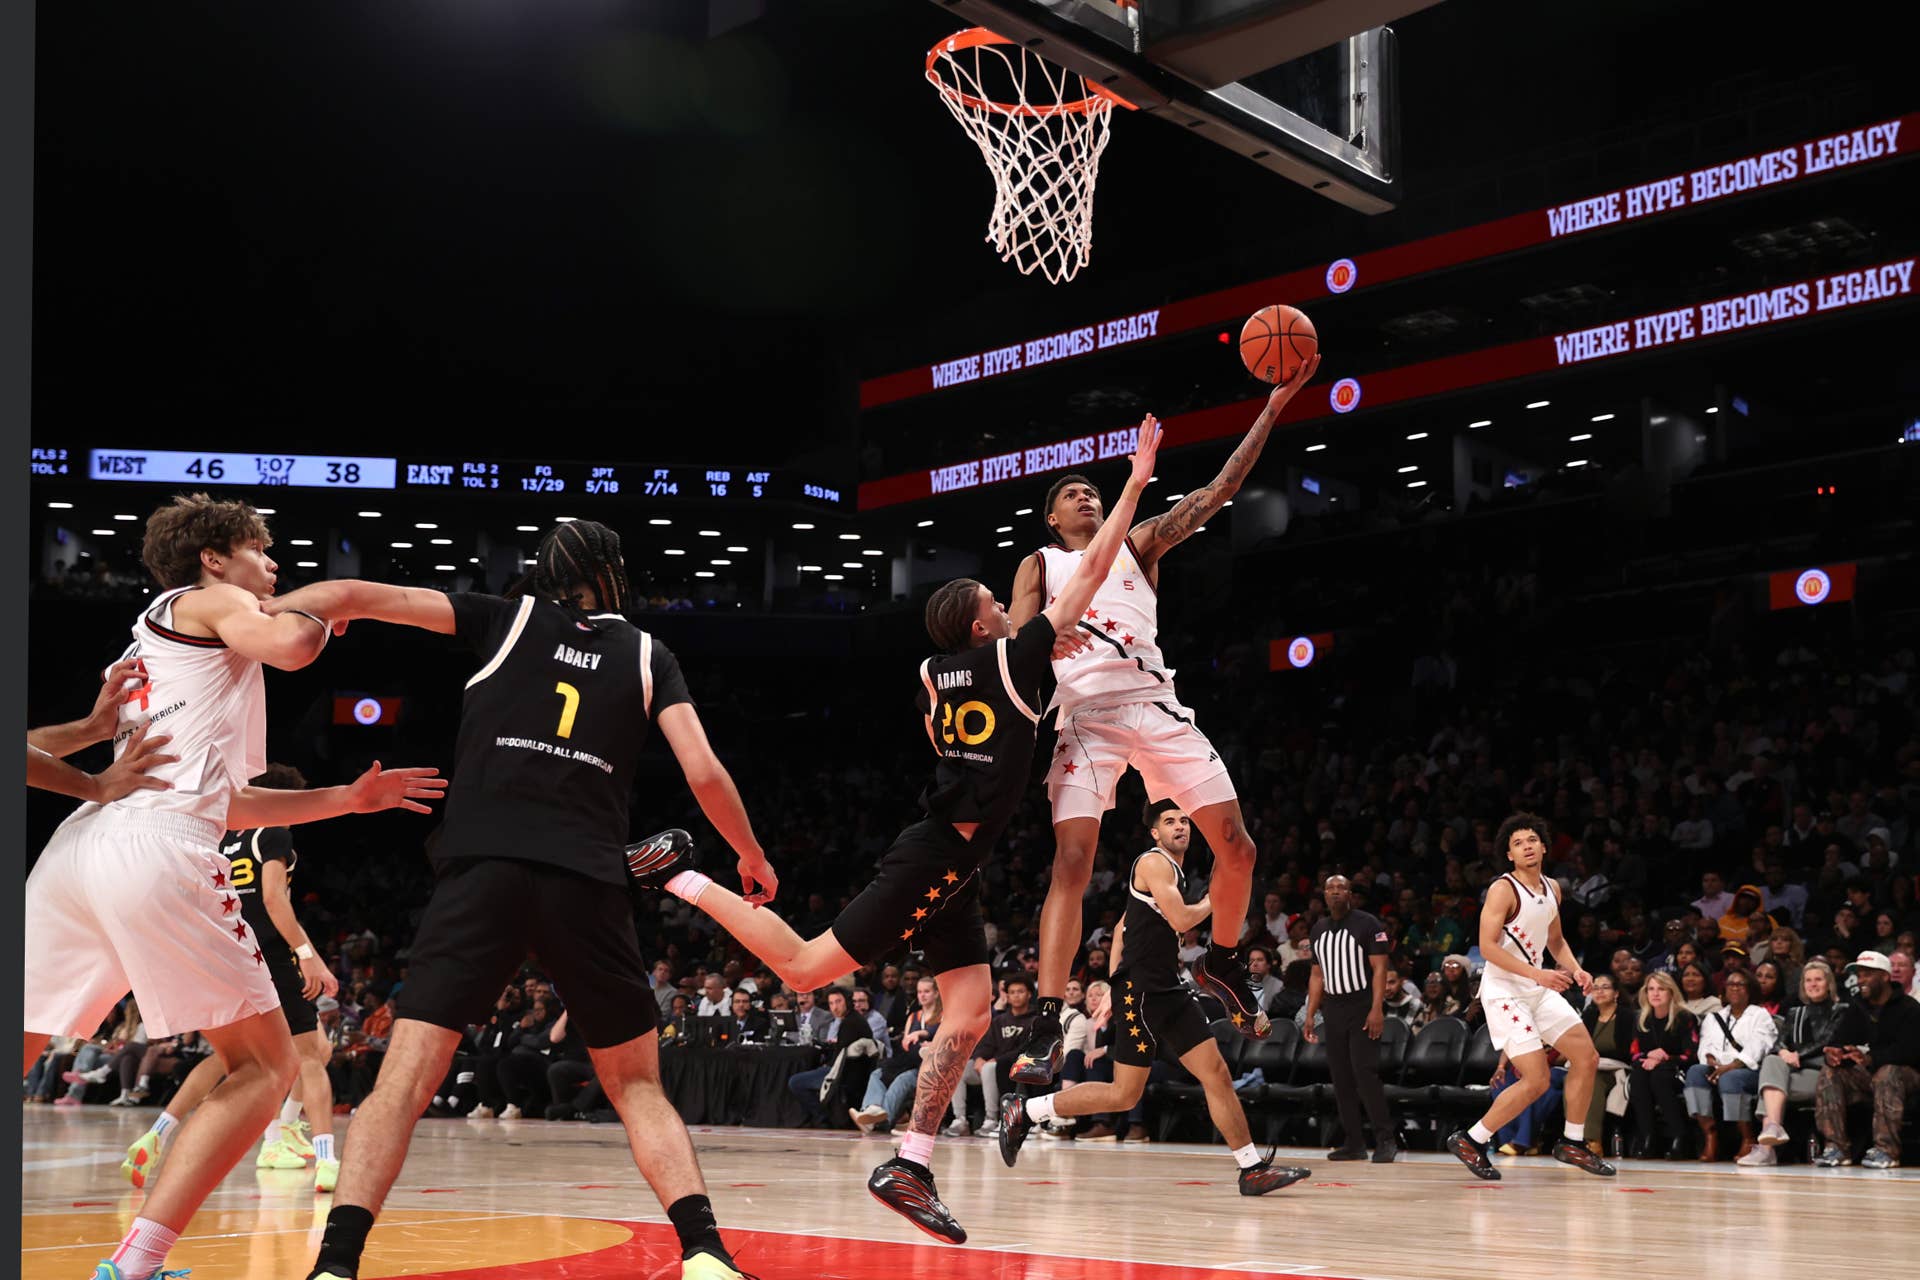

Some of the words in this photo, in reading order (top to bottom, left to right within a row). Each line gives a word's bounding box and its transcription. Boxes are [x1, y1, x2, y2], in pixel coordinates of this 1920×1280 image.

[1547, 192, 1621, 238] WHERE
[1625, 177, 1686, 219] HYPE
[1690, 148, 1798, 203] BECOMES
[1804, 120, 1901, 175] LEGACY
[1554, 320, 1630, 365] WHERE
[1634, 307, 1695, 350] HYPE
[1700, 283, 1809, 336] BECOMES
[1815, 260, 1916, 311] LEGACY
[931, 356, 980, 389] WHERE
[983, 344, 1022, 378] HYPE
[1025, 327, 1094, 368] BECOMES
[1098, 310, 1160, 350] LEGACY
[32, 448, 57, 460] FLS
[58, 449, 68, 460] 2
[930, 461, 979, 495] WHERE
[982, 448, 1022, 483] HYPE
[1025, 432, 1095, 474] BECOMES
[1098, 423, 1161, 456] LEGA
[31, 462, 56, 475] TOL
[58, 463, 68, 475] 4
[97, 456, 147, 474] WEST
[185, 458, 225, 480] 46
[255, 457, 296, 473] 1:07
[325, 462, 361, 484] 38
[407, 464, 454, 485] EAST
[462, 462, 486, 475] FLS
[490, 464, 499, 475] 2
[535, 465, 552, 477] FG
[592, 467, 615, 478] 3PT
[654, 469, 669, 480] FT
[258, 472, 290, 487] 2nd
[462, 476, 486, 488] TOL
[490, 478, 499, 489] 3
[705, 471, 730, 482] REB
[746, 472, 771, 483] AST
[521, 478, 565, 493] 13/29
[585, 479, 619, 495] 5/18
[644, 481, 678, 496] 7/14
[710, 483, 727, 496] 16
[753, 485, 762, 497] 5
[824, 488, 840, 502] PM
[1123, 580, 1135, 591] 5
[554, 643, 602, 671] ABAEV
[937, 669, 973, 691] ADAMS
[150, 700, 187, 725] MERICAN
[555, 681, 580, 739] 1
[553, 746, 572, 758] ALL
[572, 750, 614, 774] AMERICAN
[1001, 1025, 1024, 1039] 1977
